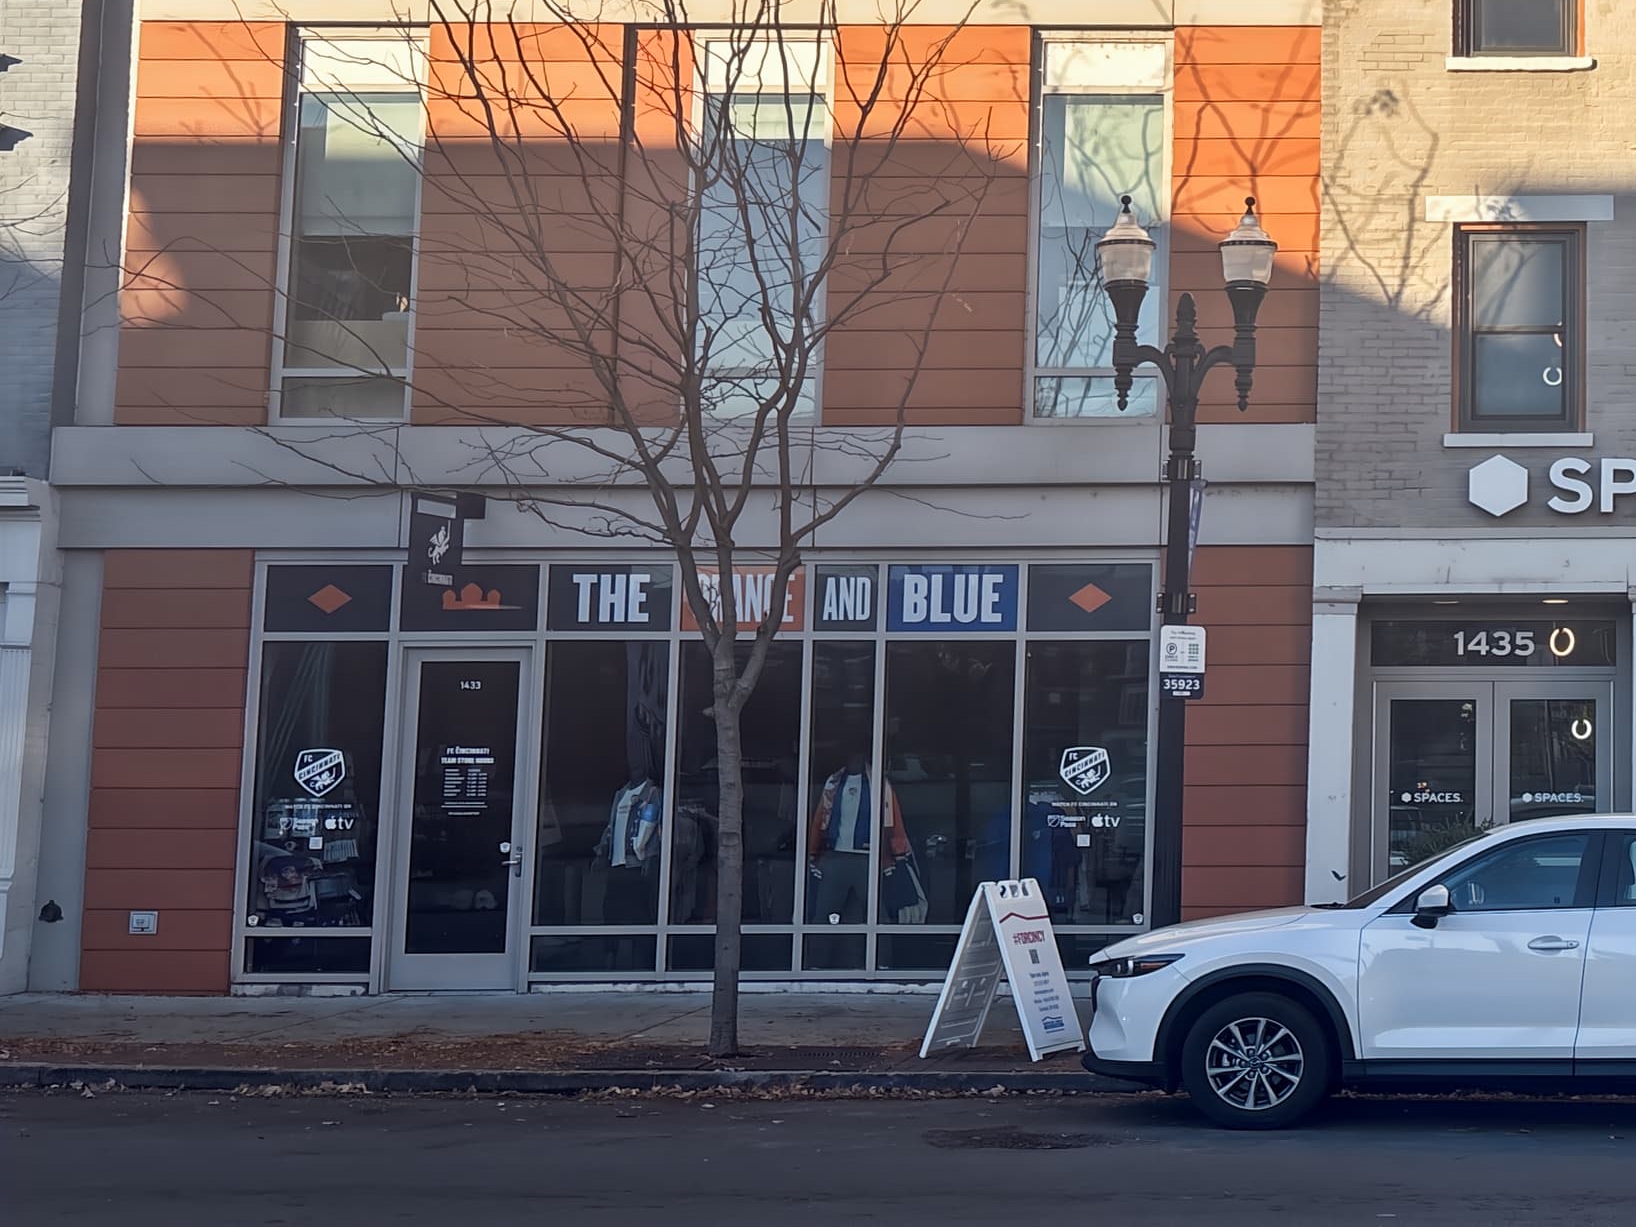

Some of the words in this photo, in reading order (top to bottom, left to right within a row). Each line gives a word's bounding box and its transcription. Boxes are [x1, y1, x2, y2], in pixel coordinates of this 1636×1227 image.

[573, 574, 650, 622] THE
[823, 577, 871, 620] AND
[903, 574, 1003, 623] BLUE
[1453, 631, 1535, 656] 1435
[460, 681, 481, 690] 1433
[1163, 679, 1200, 690] 35923
[1414, 792, 1463, 803] SPACES.
[1534, 792, 1584, 803] SPACES.
[337, 818, 354, 829] tv
[1104, 814, 1120, 827] tv
